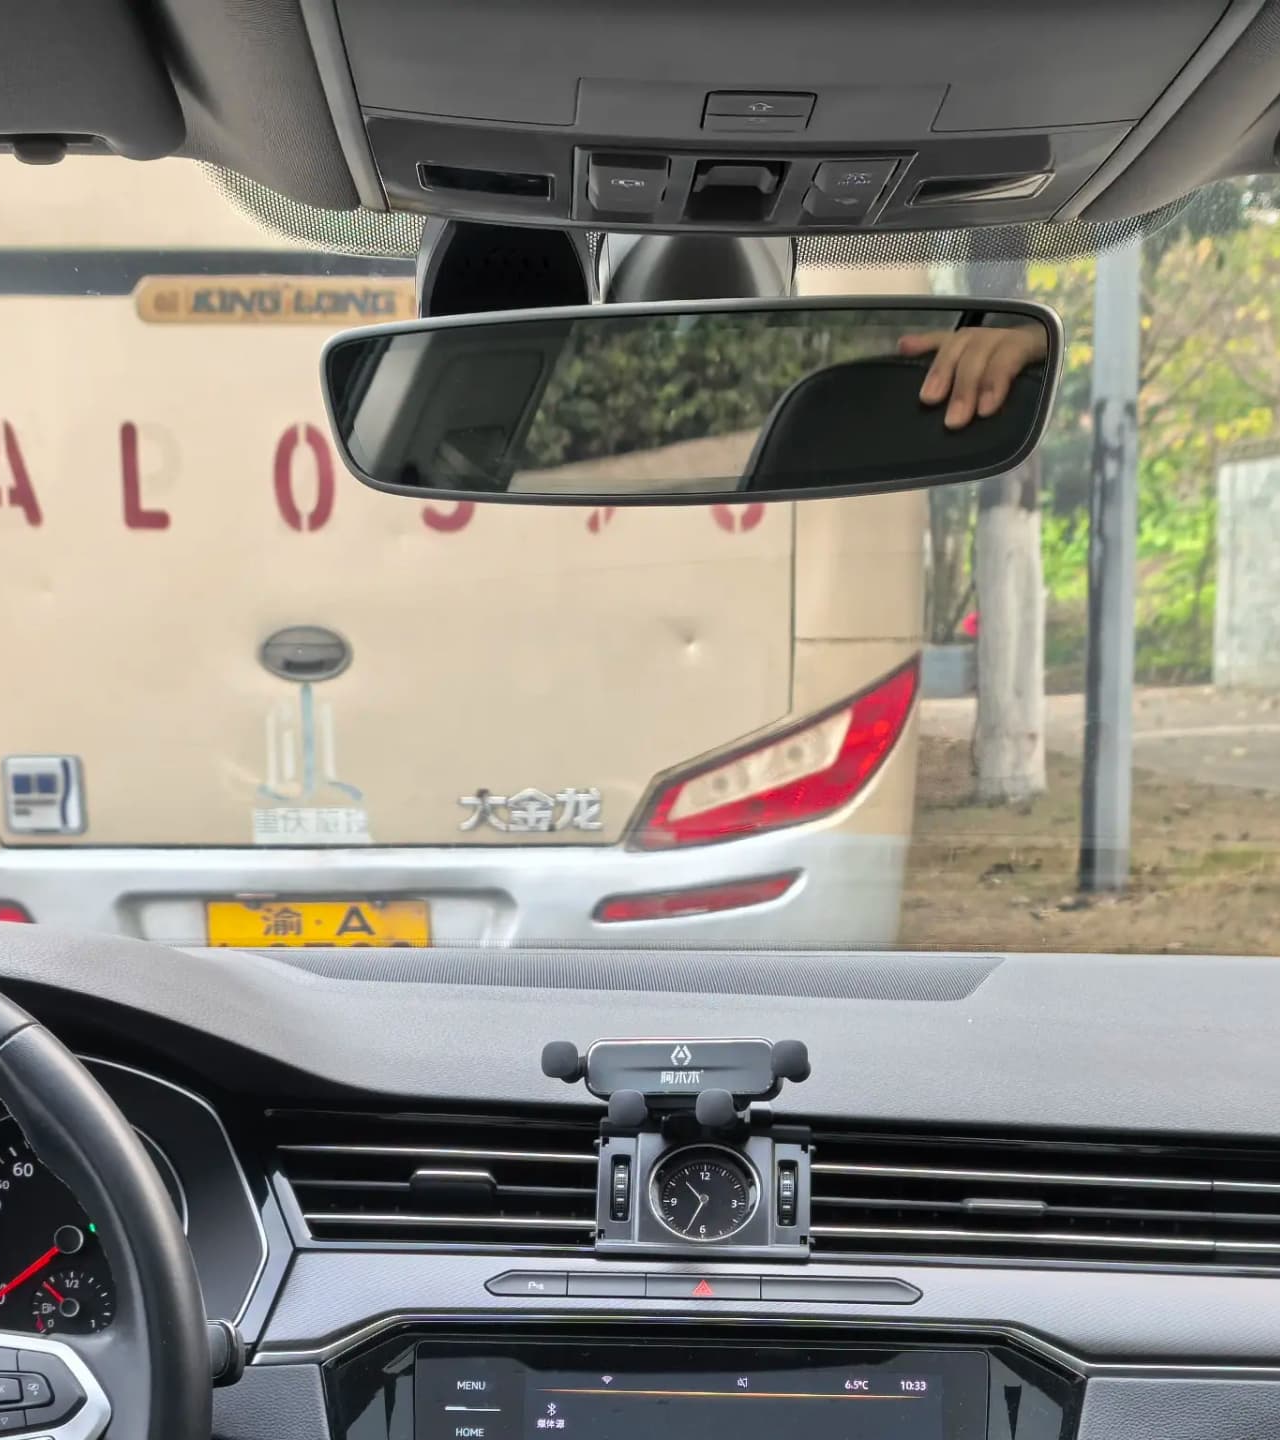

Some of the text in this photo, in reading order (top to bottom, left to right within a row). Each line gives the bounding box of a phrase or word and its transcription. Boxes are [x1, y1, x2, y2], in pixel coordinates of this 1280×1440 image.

[191, 287, 281, 315] KING
[293, 287, 397, 315] LONG
[458, 787, 603, 832] 大金龙
[660, 1070, 702, 1085] 阿木木
[12, 1162, 34, 1177] 60
[699, 1171, 711, 1181] 12
[671, 1198, 678, 1207] 9
[731, 1199, 738, 1209] 3
[699, 1225, 707, 1234] 6
[65, 1279, 80, 1289] 1/2
[47, 1319, 55, 1328] 0
[90, 1319, 96, 1329] 1
[456, 1380, 486, 1391] MENU
[900, 1380, 927, 1391] 10:33
[455, 1427, 485, 1438] HOME
